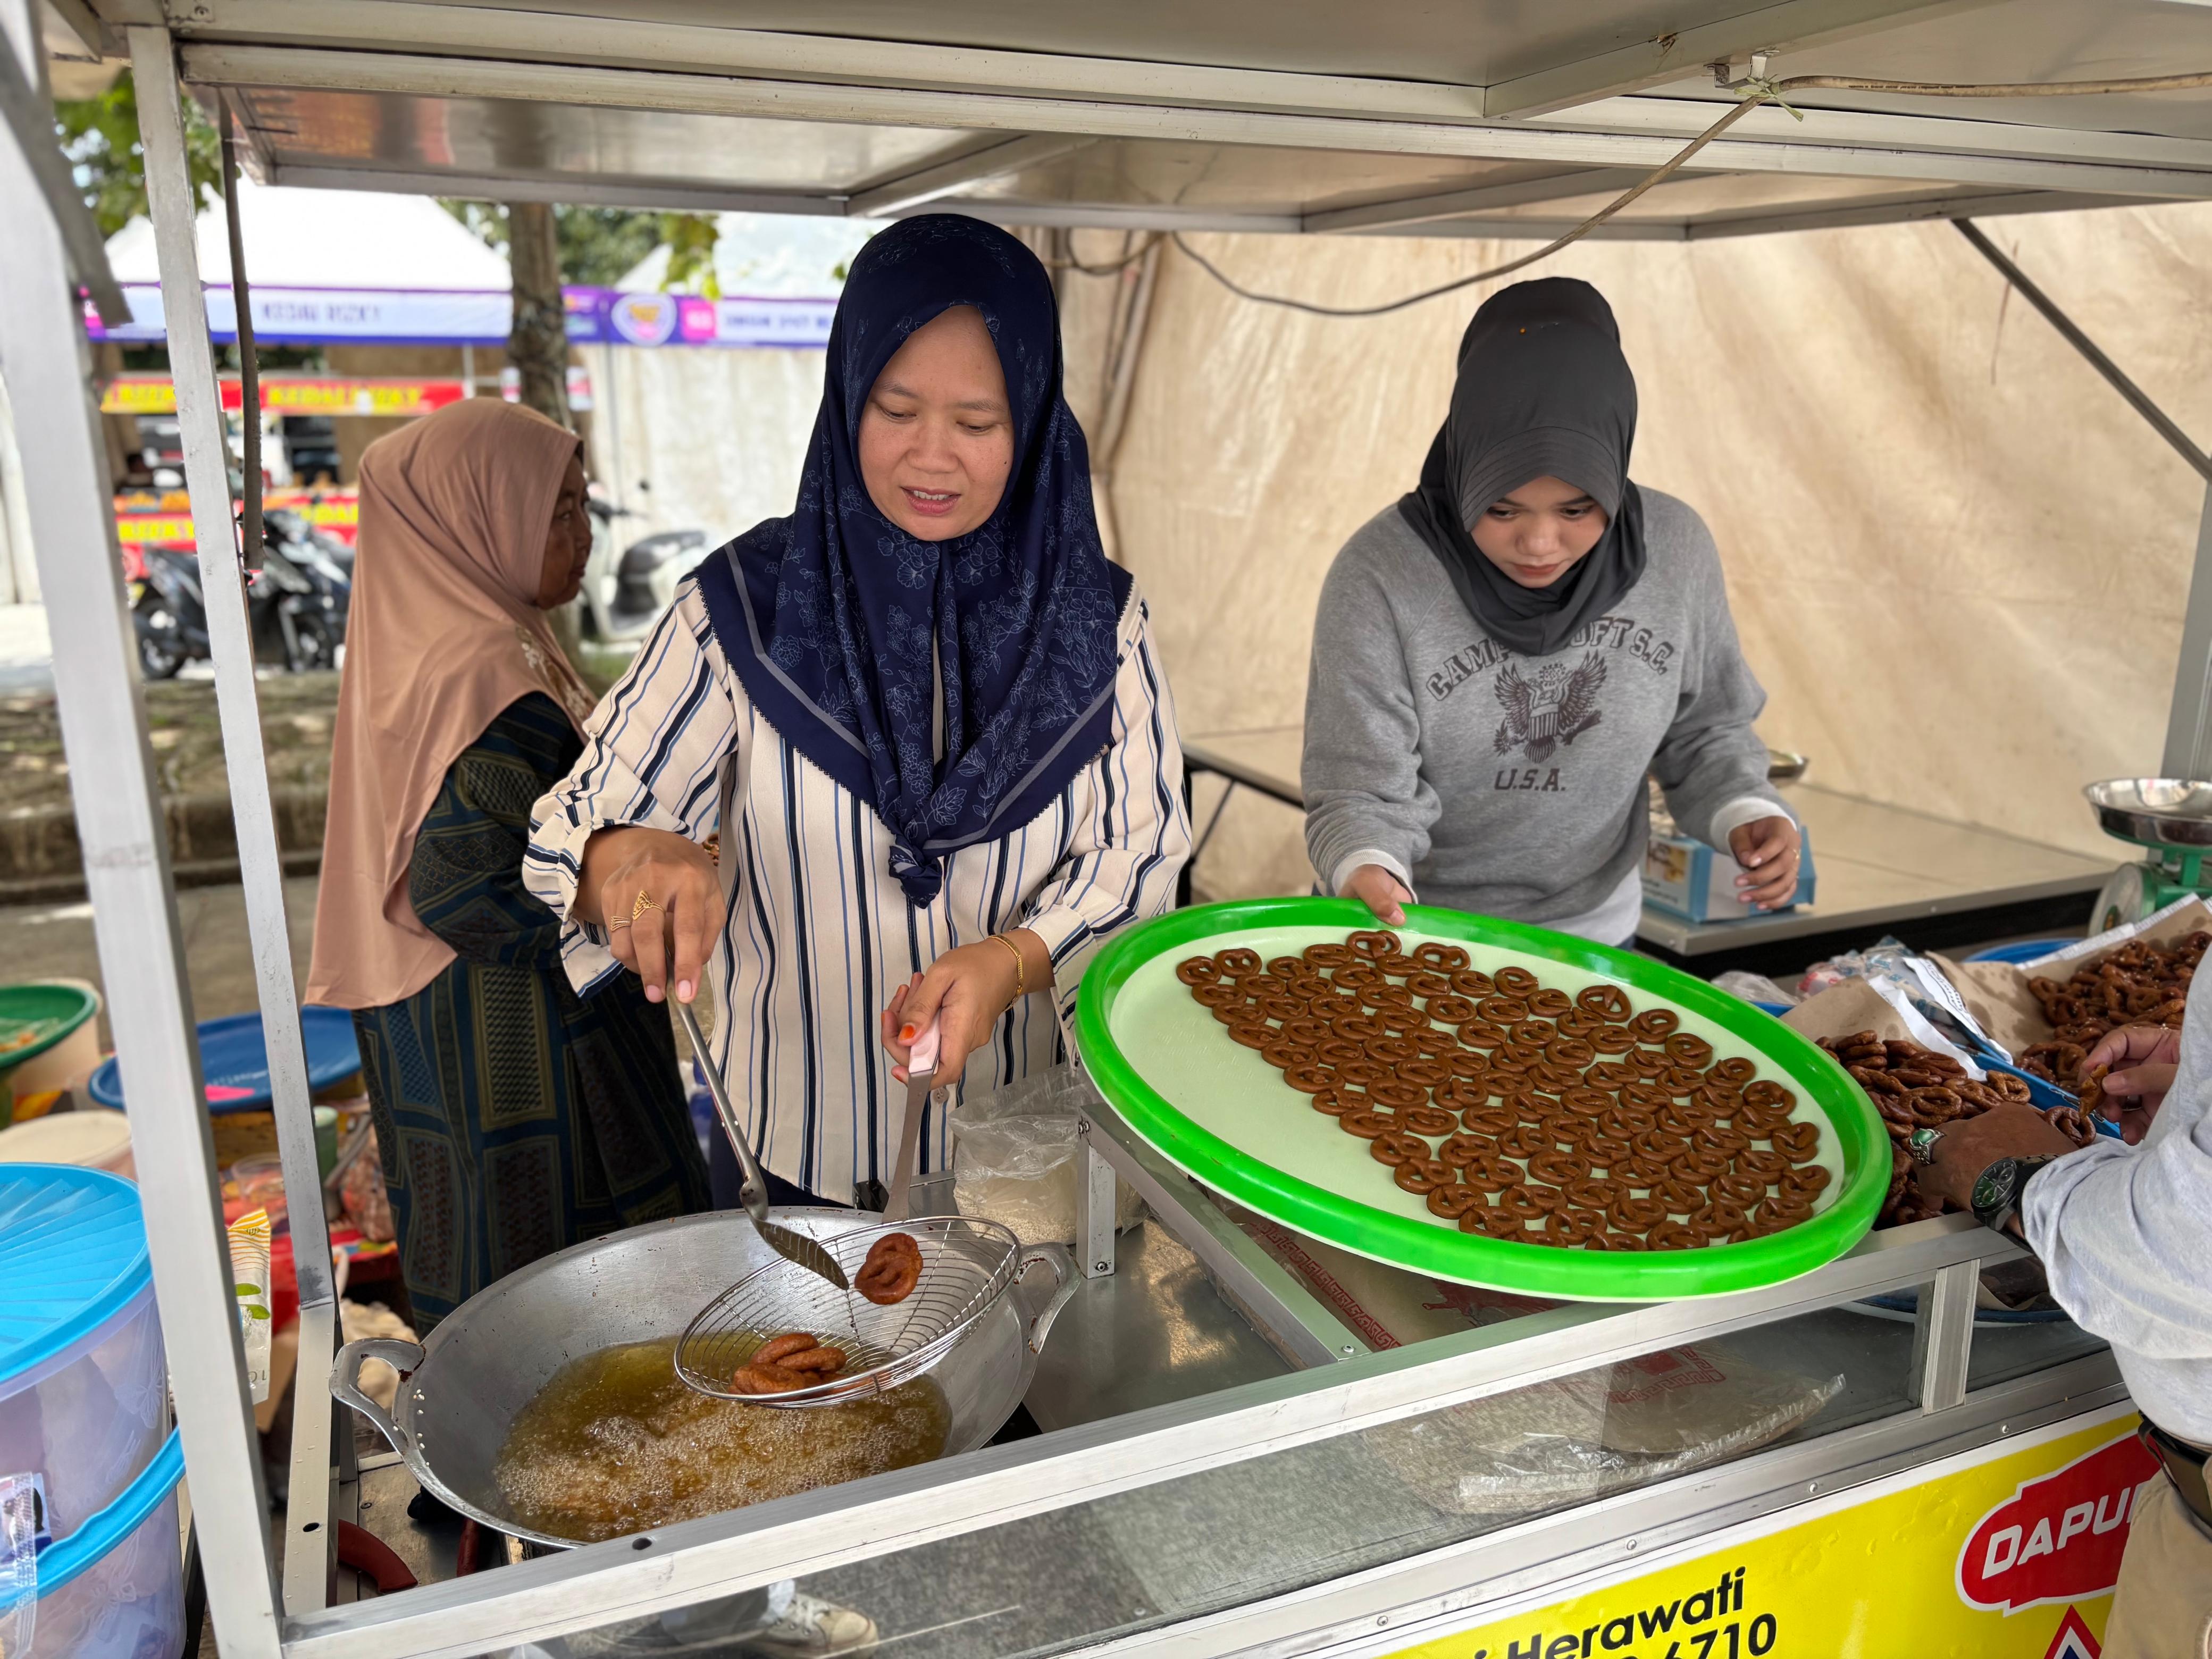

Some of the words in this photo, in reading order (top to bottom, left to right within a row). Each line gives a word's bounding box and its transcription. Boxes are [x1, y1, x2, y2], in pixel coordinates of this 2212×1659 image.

[1426, 637, 1510, 701] CAMP
[1629, 628, 1674, 675] S.C.
[1494, 768, 1566, 791] U.S.A.
[1507, 1566, 1746, 1659] Herawati
